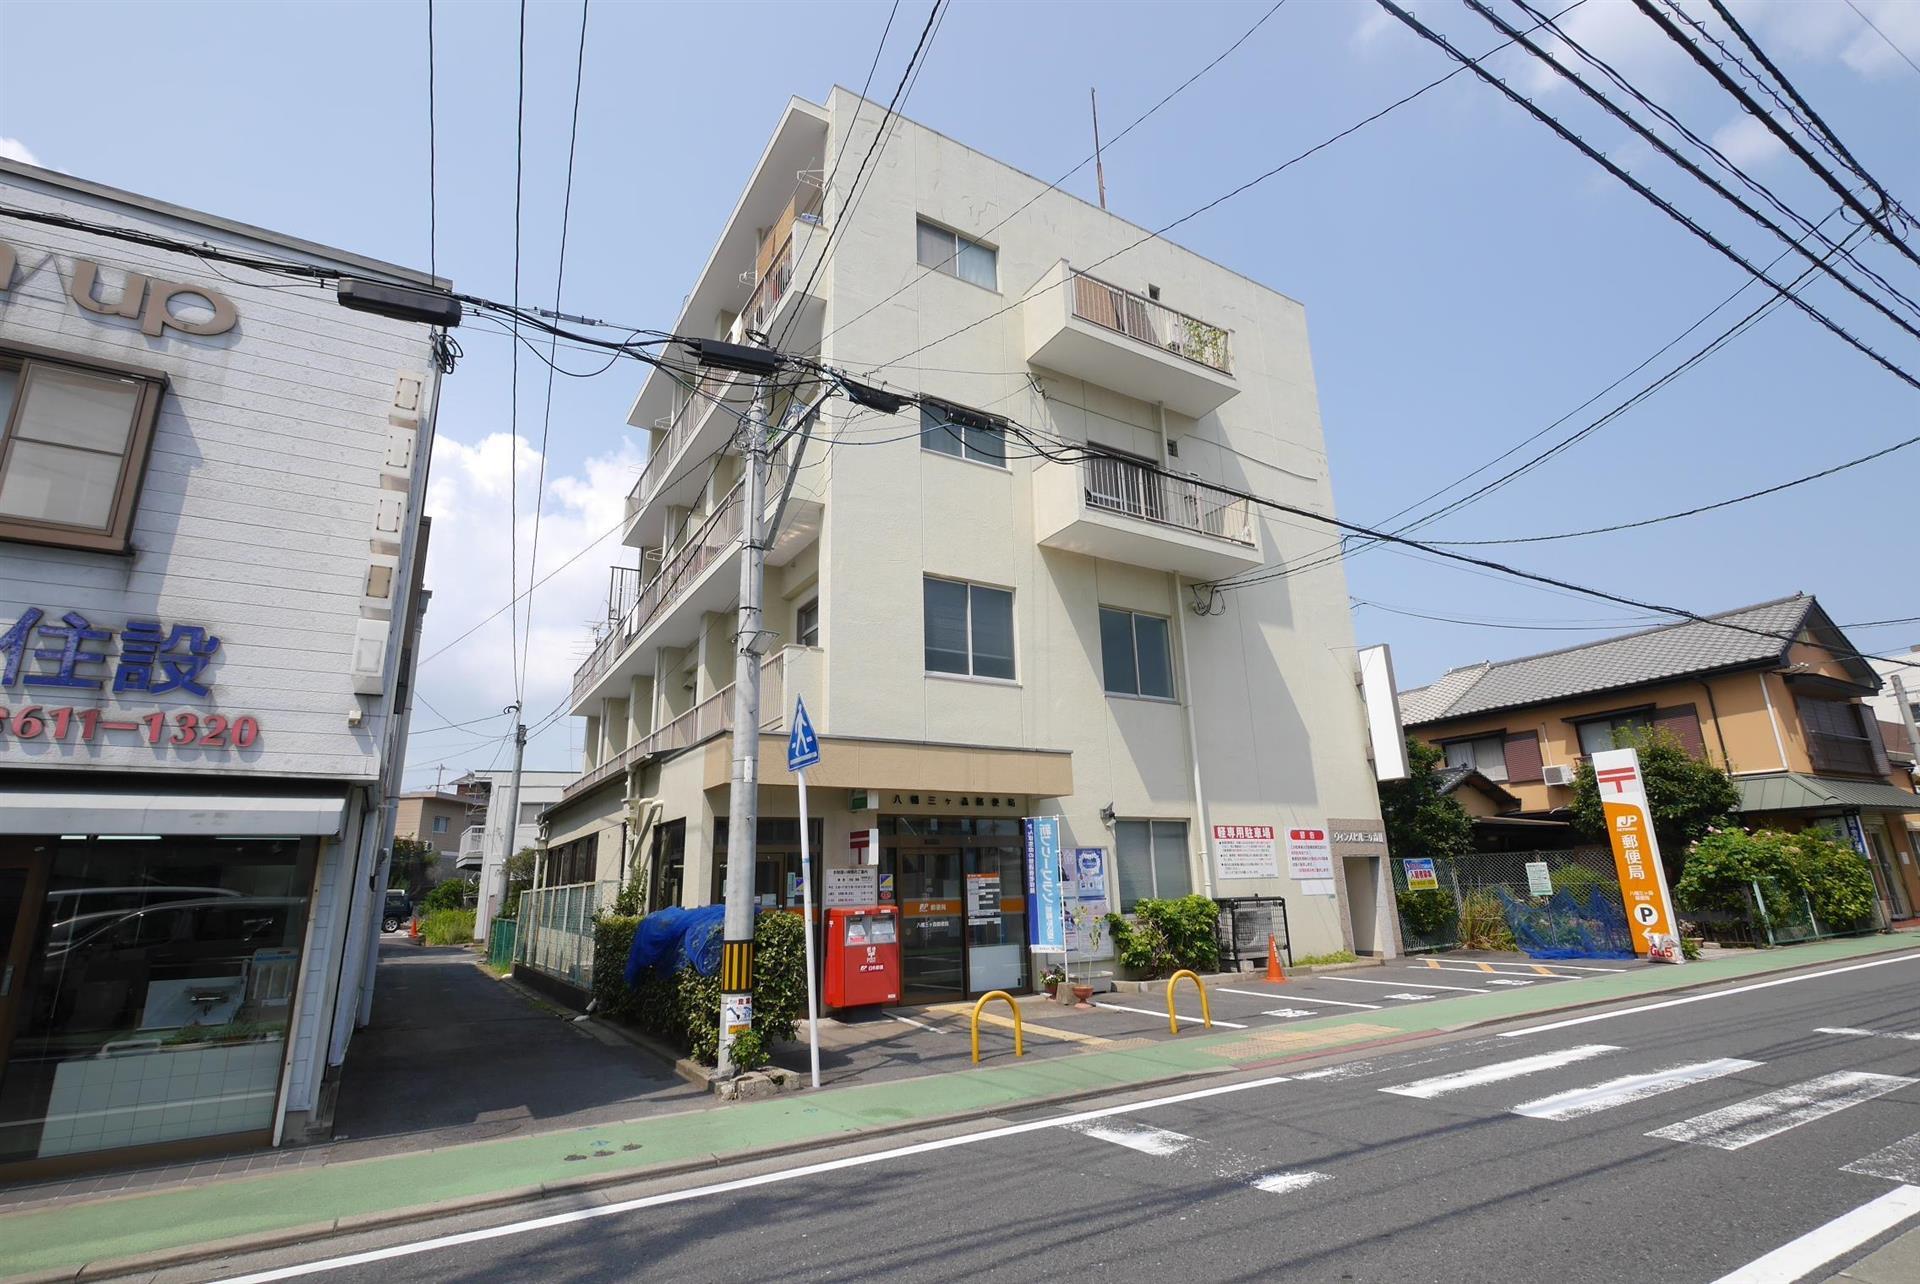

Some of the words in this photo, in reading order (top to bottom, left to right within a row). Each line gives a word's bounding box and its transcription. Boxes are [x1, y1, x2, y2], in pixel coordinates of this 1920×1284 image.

[0, 607, 221, 697] 住設
[0, 706, 260, 748] 611-1320
[893, 794, 1016, 808] 八三ヶ森便局
[1621, 834, 1645, 880] 郵便局
[1640, 907, 1653, 922] P
